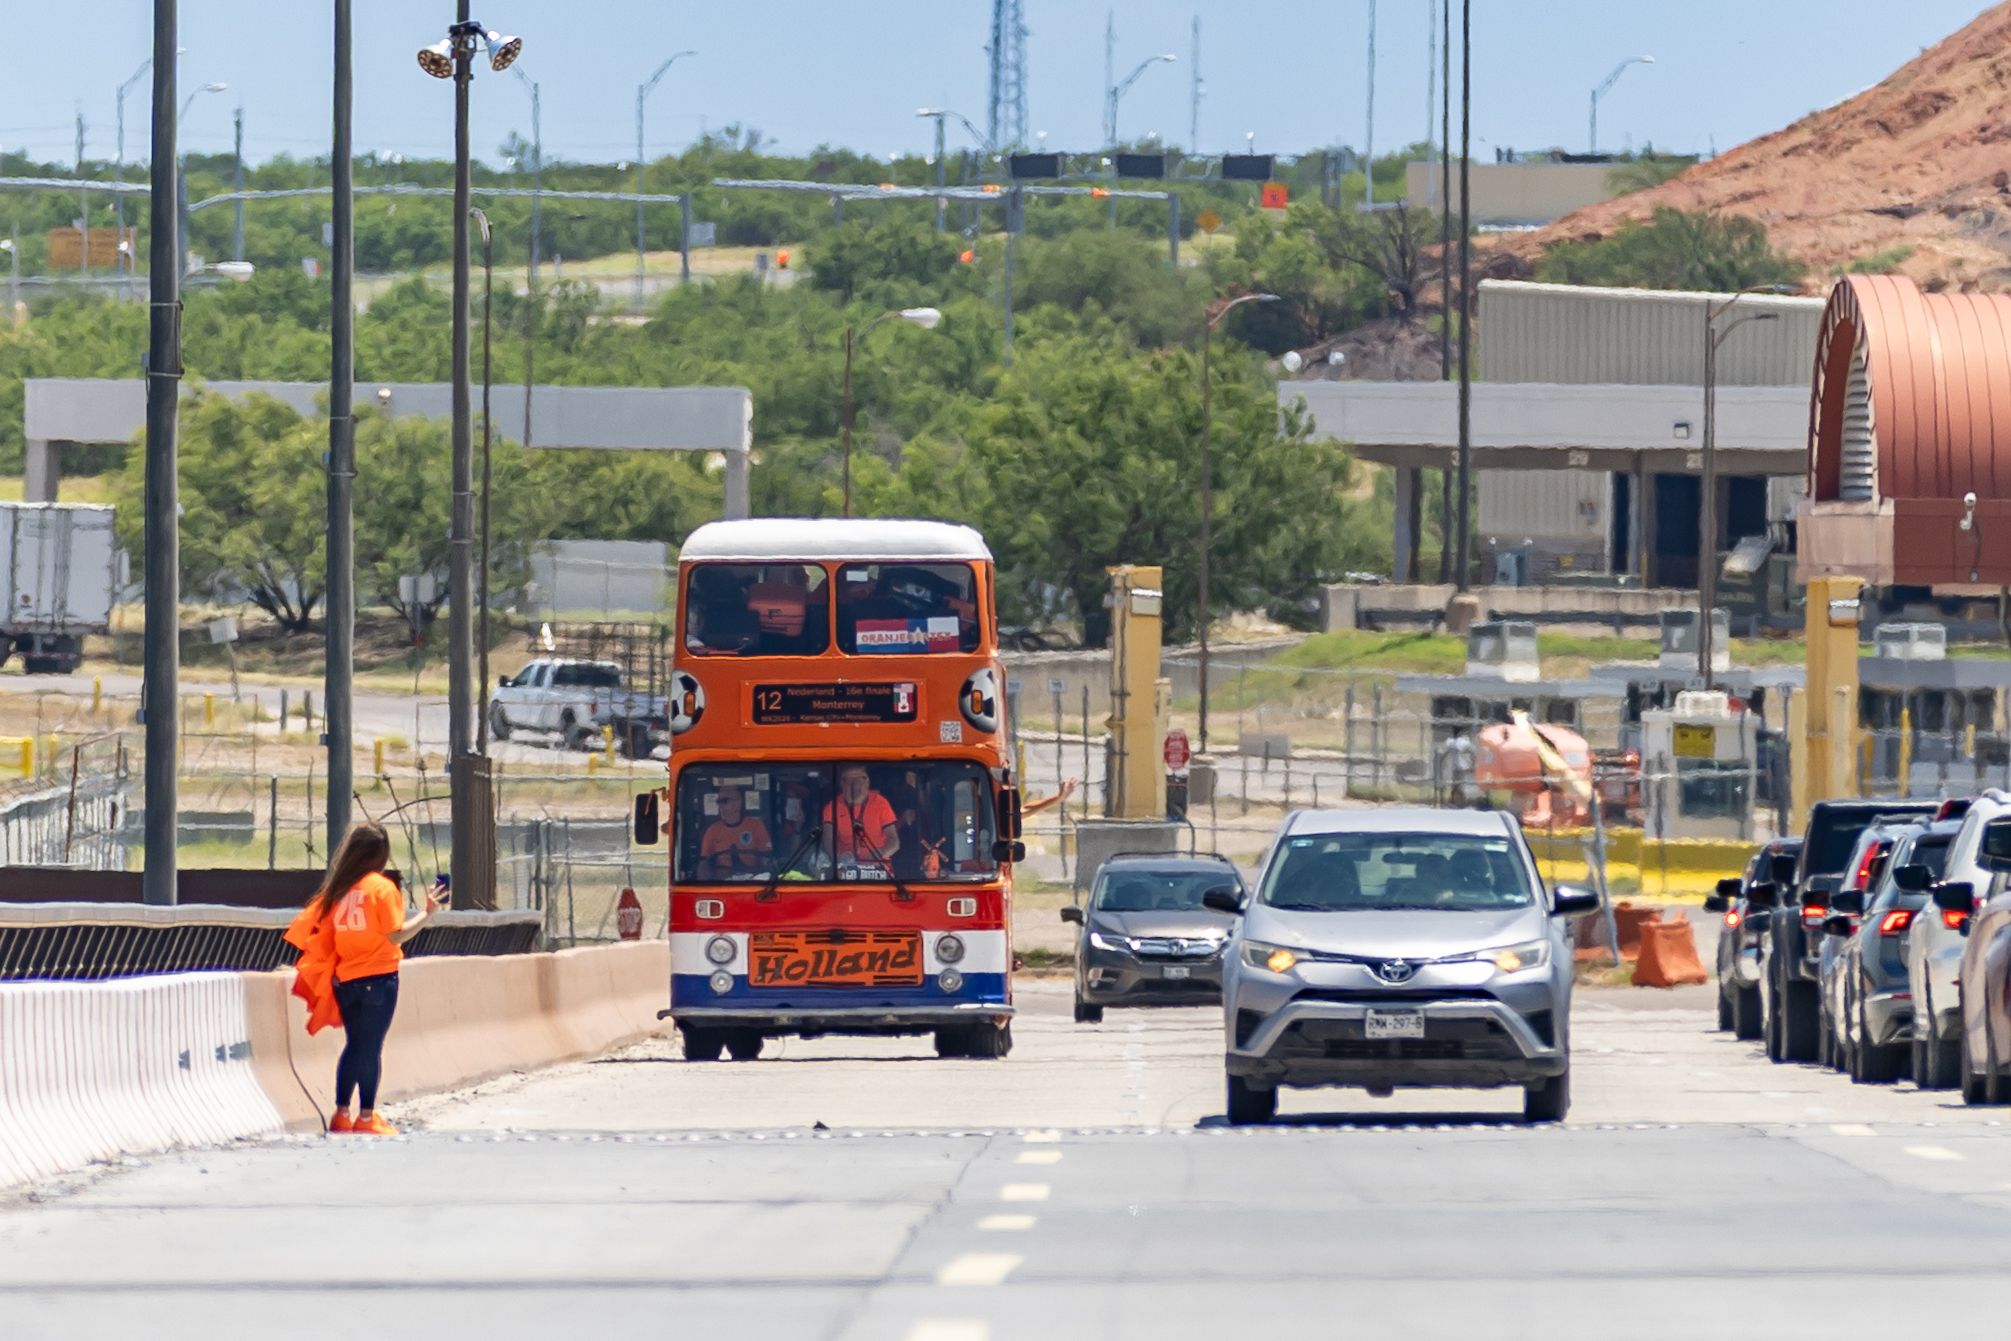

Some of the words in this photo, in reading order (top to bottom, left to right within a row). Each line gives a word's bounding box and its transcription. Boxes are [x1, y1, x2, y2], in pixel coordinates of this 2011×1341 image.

[757, 691, 782, 711] 12
[787, 686, 835, 696] Nederland
[812, 700, 865, 711] Monterrey
[333, 889, 367, 931] 26
[754, 939, 920, 984] Holland
